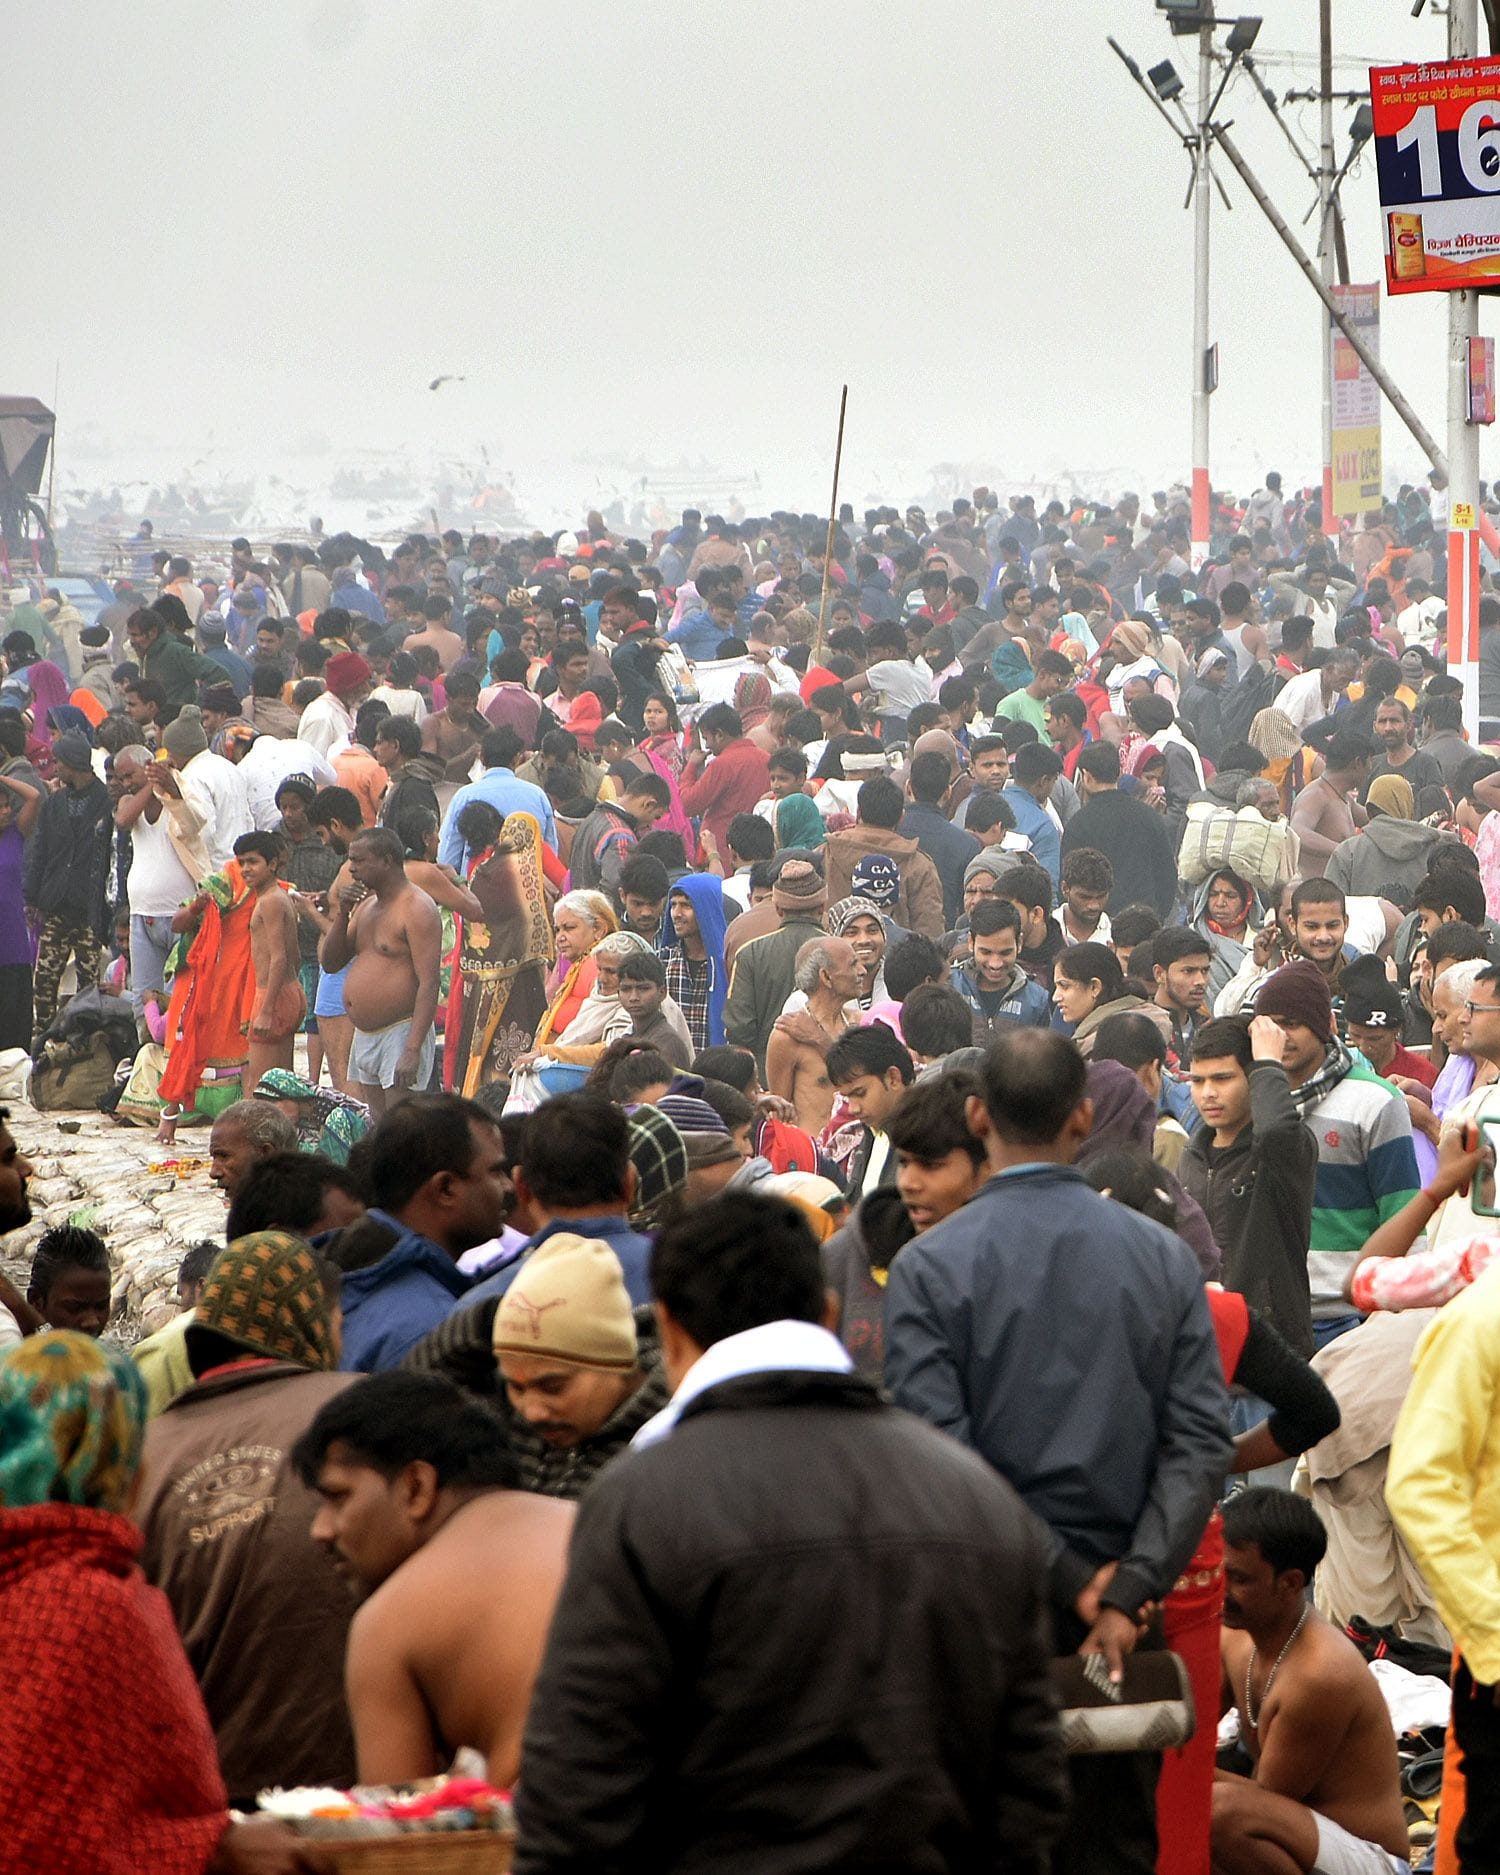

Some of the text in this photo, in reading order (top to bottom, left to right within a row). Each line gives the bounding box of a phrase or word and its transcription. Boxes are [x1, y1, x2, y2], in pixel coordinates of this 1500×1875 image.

[1456, 503, 1471, 514] S-1
[871, 865, 891, 874] GA
[873, 879, 895, 888] GA
[1365, 1011, 1387, 1026] R
[175, 1445, 283, 1494] UNITED STATES
[189, 1497, 277, 1545] SUPPORT
